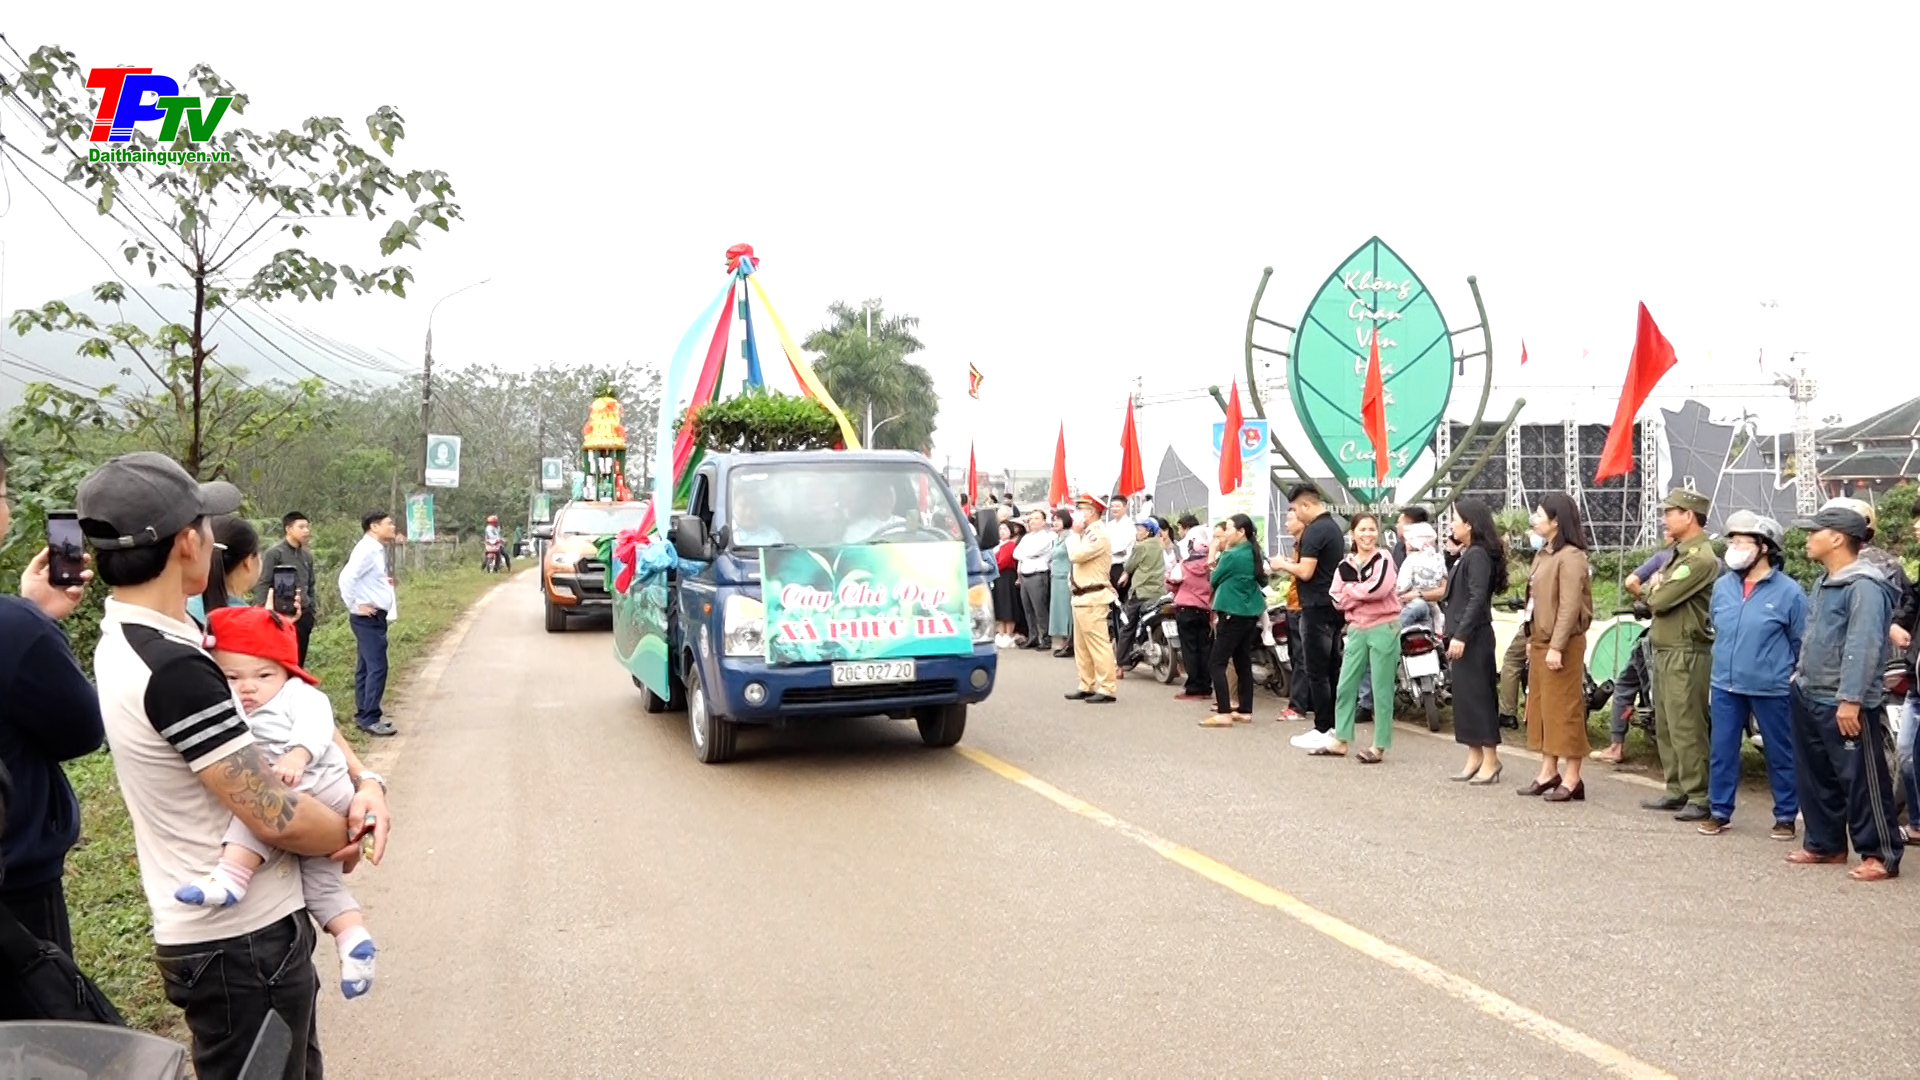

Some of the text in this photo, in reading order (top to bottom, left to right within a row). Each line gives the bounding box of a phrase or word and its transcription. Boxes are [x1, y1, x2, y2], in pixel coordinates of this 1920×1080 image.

[1343, 270, 1411, 300] Không
[1348, 298, 1403, 321] Gian
[781, 582, 948, 611] Cây Chè Đẹp
[915, 611, 957, 636] HÀ
